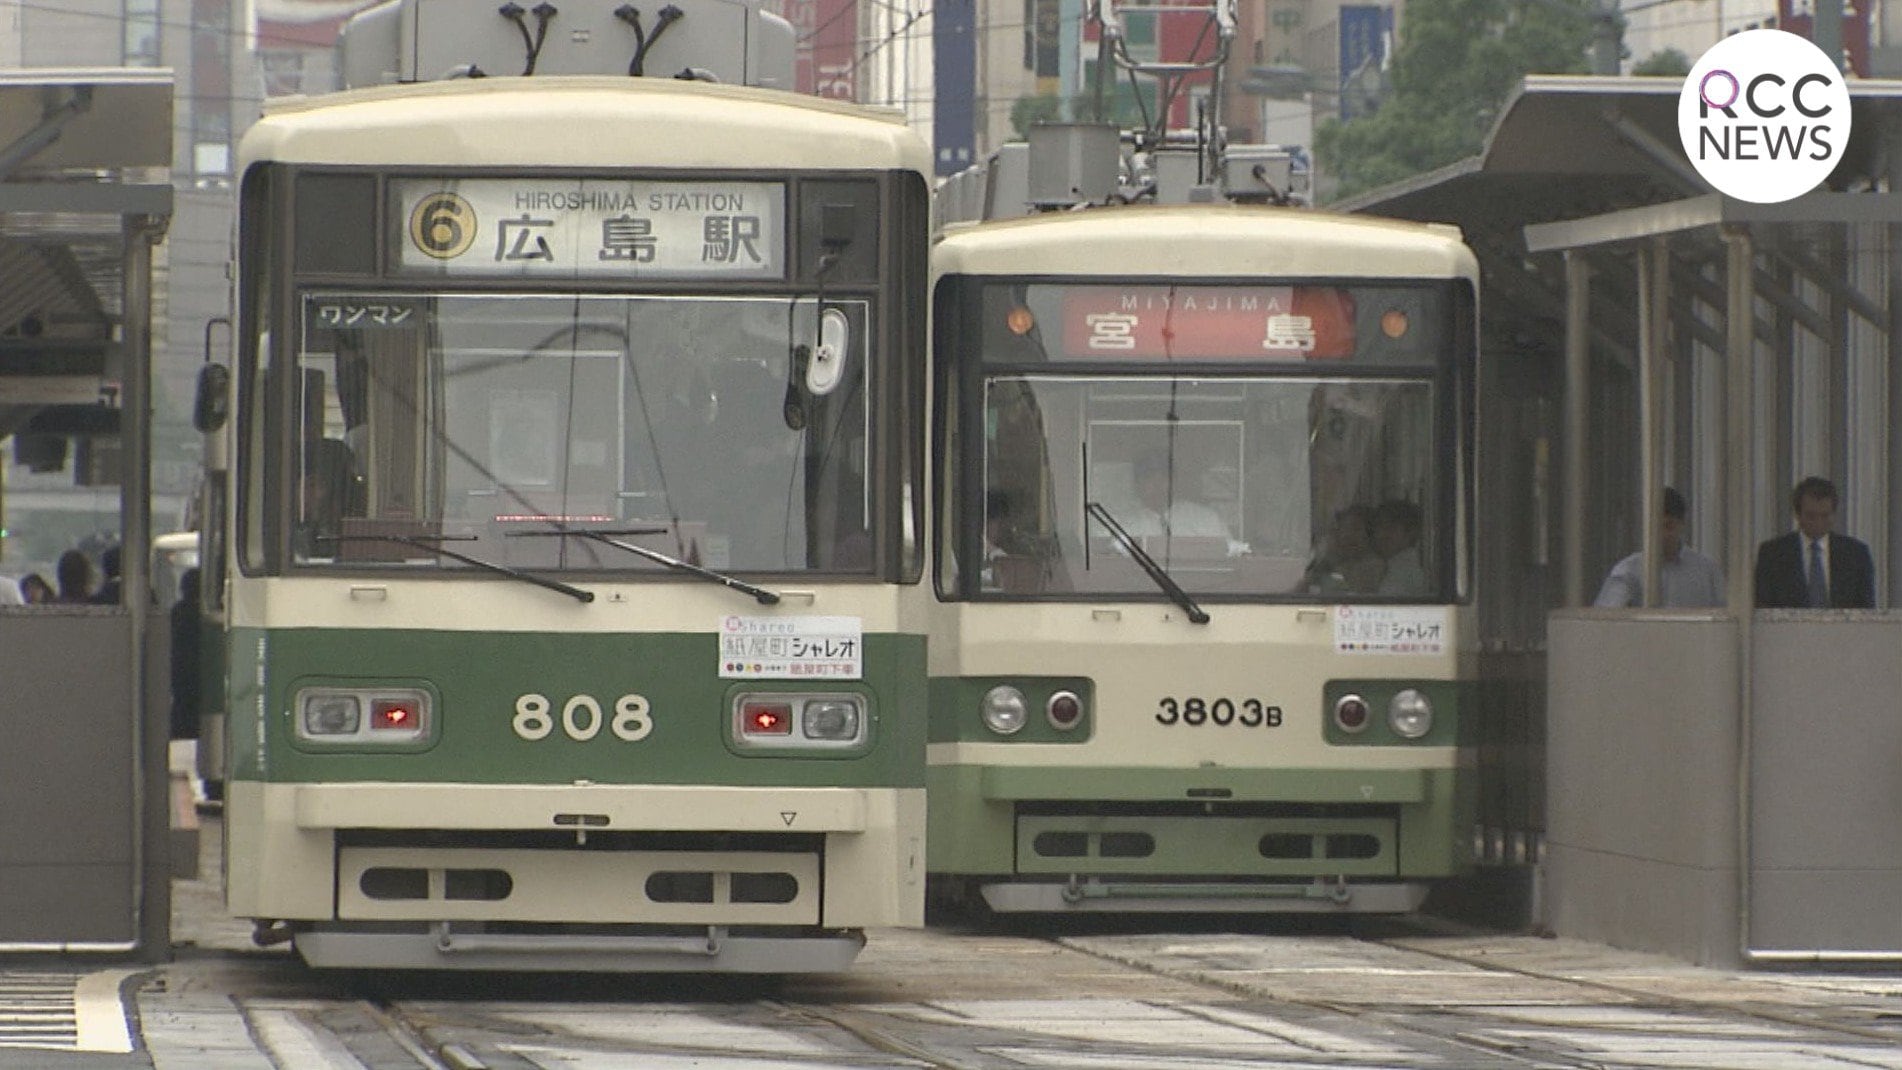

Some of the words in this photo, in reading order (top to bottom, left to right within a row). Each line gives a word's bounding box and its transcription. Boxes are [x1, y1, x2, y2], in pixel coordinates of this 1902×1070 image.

[514, 191, 638, 211] HIROSHIMA
[649, 192, 745, 211] STATION
[419, 199, 463, 252] 6
[495, 213, 763, 264] 広島駅
[321, 305, 412, 324] ワンマン
[1121, 295, 1281, 312] MIYAJIMA
[512, 693, 654, 742] 808
[1154, 696, 1283, 728] 3803B
